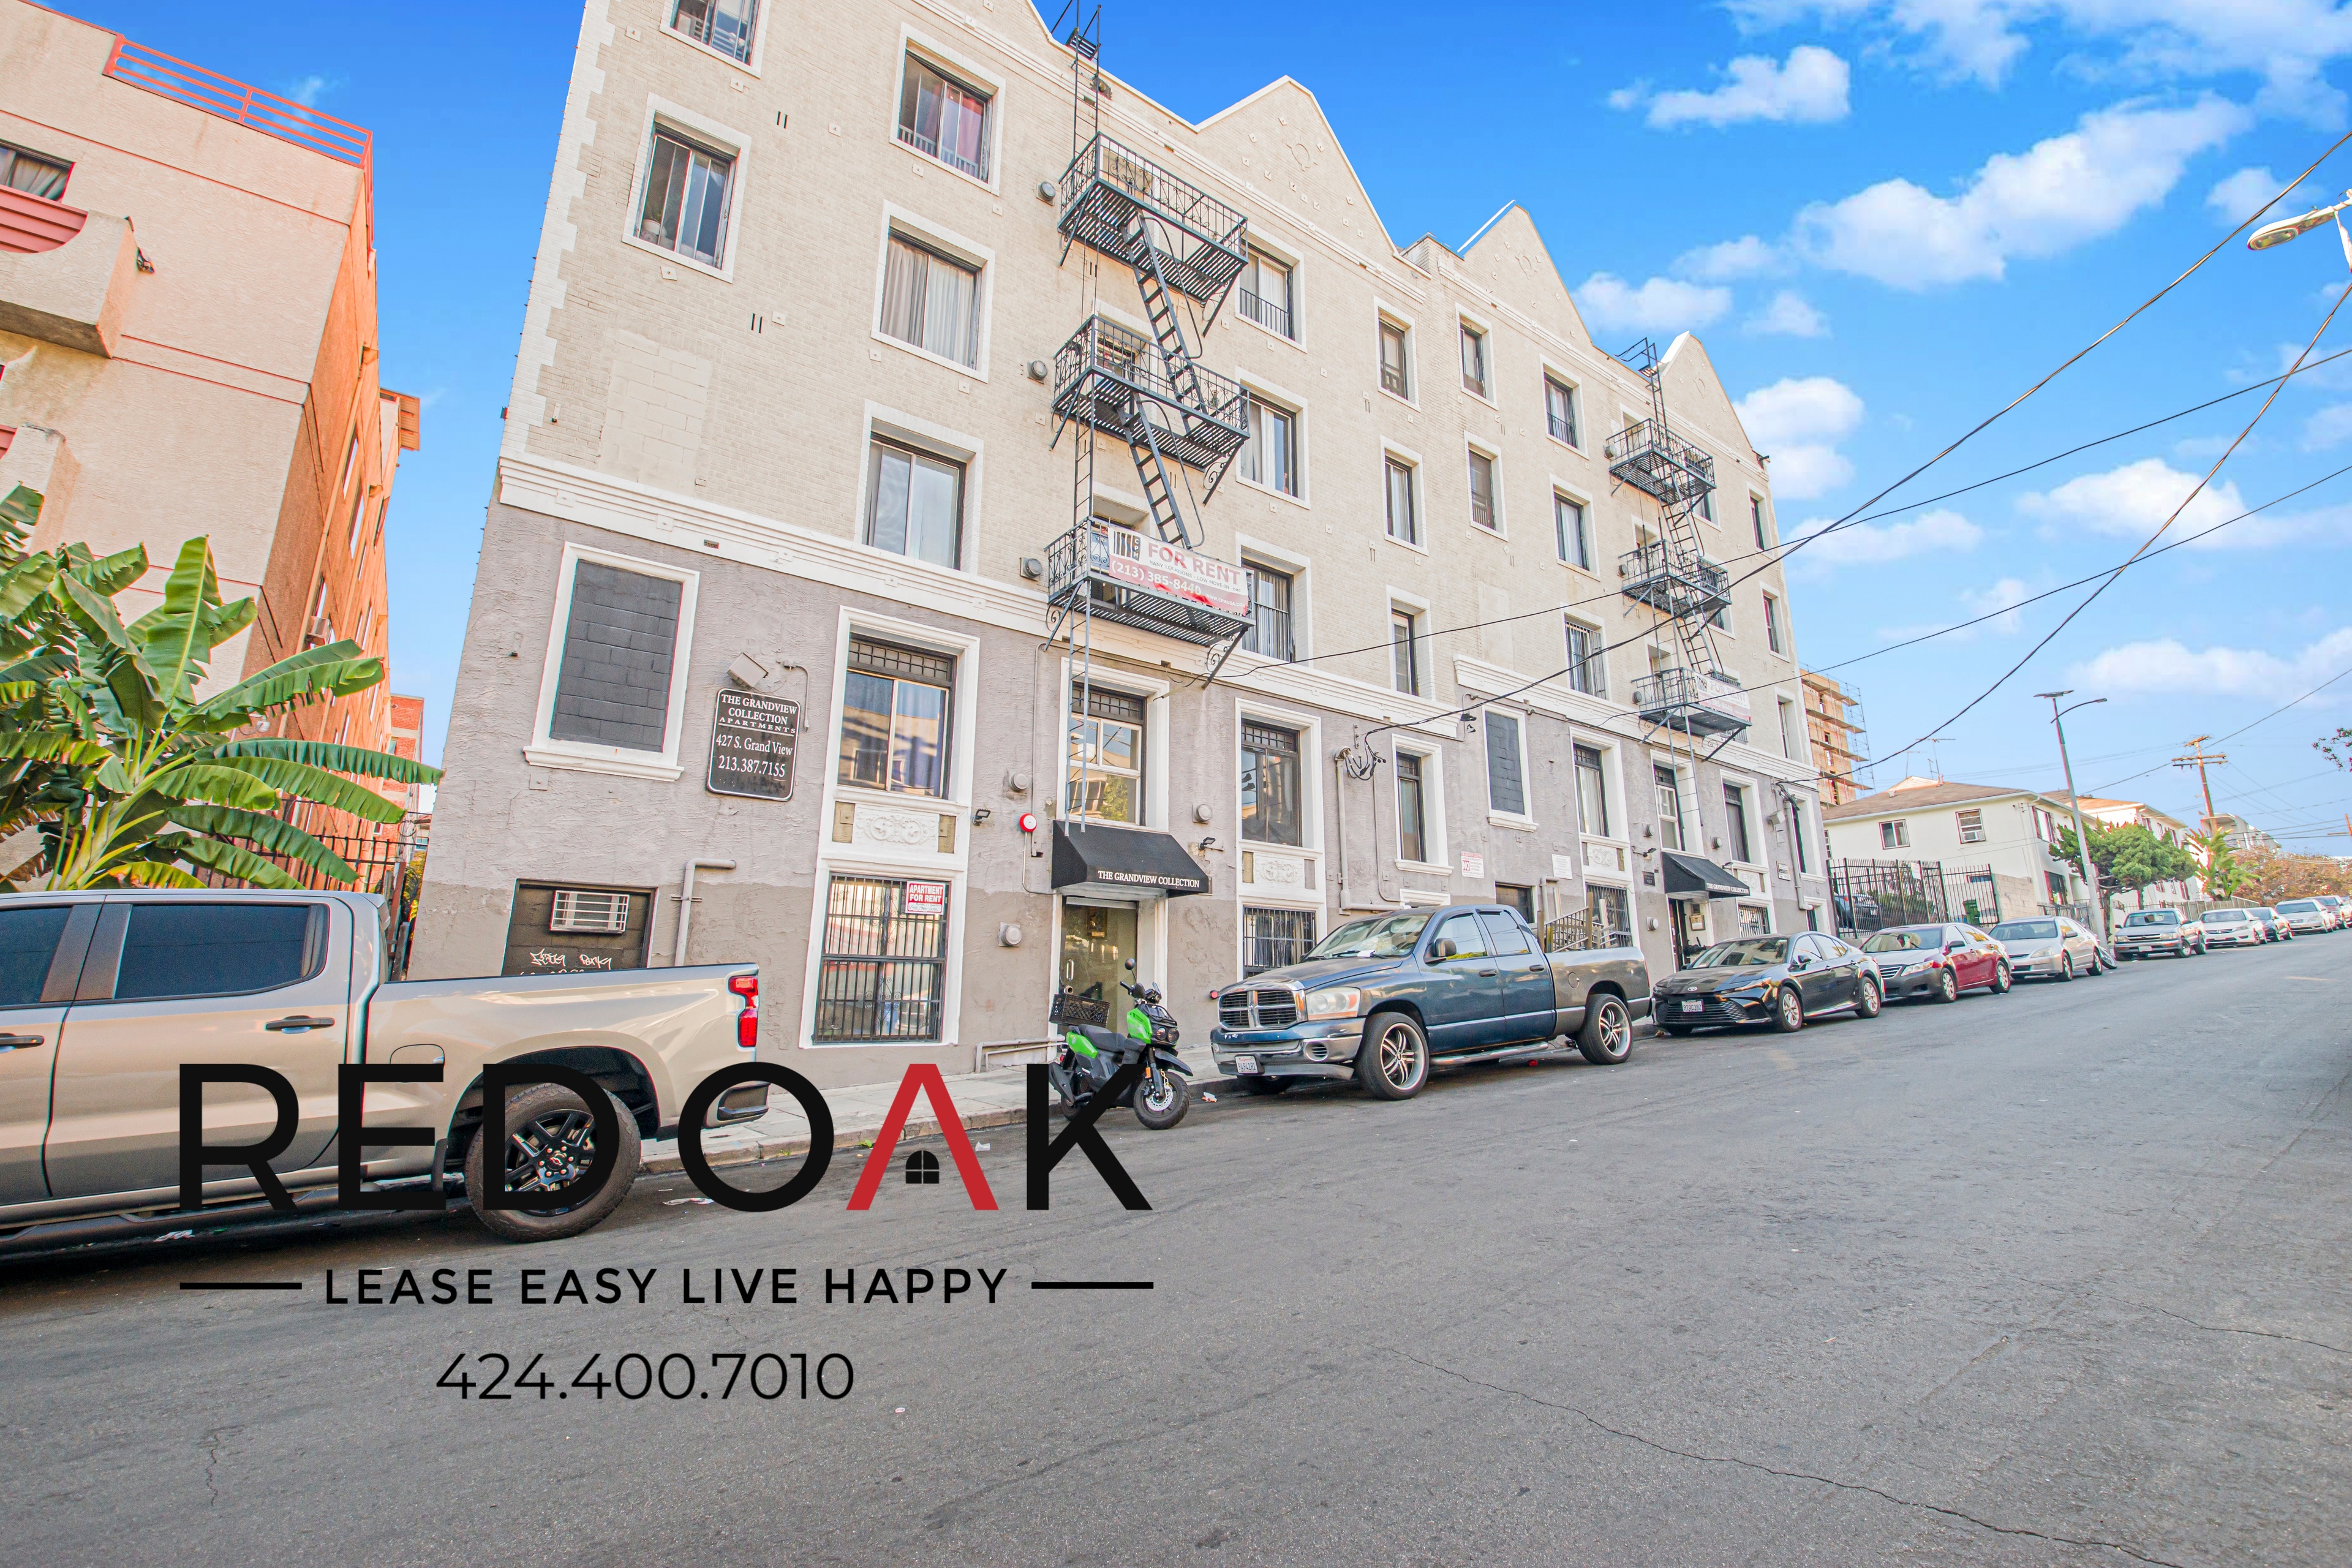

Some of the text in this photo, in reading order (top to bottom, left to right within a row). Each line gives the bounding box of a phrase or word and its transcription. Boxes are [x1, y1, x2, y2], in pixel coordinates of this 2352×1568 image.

[1148, 542, 1240, 585] FOR RENT
[1112, 560, 1201, 595] (213) 385-8440
[1165, 564, 1192, 578] LOCATIONS
[1209, 580, 1230, 589] MOVE-IN
[1710, 681, 1746, 702] FOR RENT
[722, 694, 797, 715] THE GRANDVIEW
[719, 717, 796, 733] APARTMENTS
[728, 707, 788, 725] COLLECTION
[716, 734, 793, 755] 427 S. Grand View
[718, 755, 785, 777] 213.387.7155
[1463, 861, 1469, 870] NO
[910, 884, 943, 895] APARTMENT
[1098, 870, 1199, 888] THE GRANDVIEW COLLECTION
